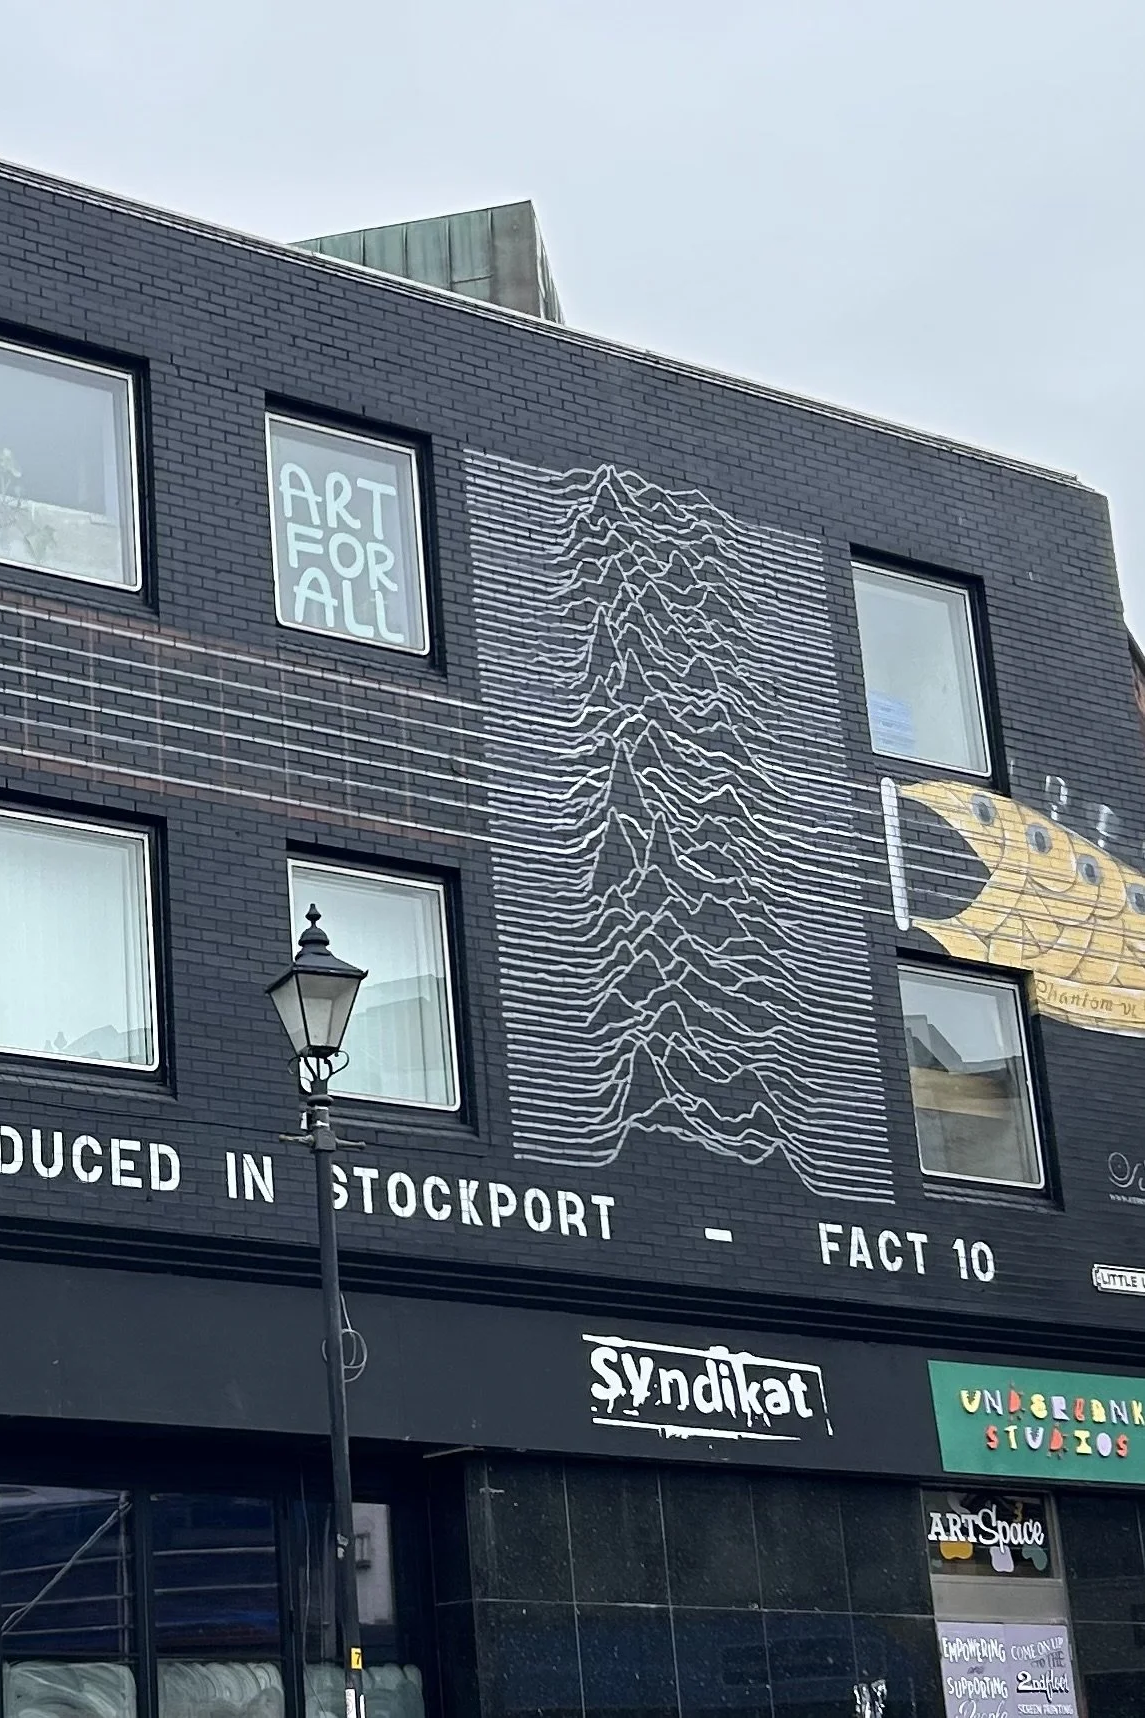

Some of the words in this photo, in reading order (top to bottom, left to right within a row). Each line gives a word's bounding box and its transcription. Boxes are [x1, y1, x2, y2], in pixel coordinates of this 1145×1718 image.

[279, 463, 396, 540] ART
[287, 522, 398, 592] FOR
[294, 567, 404, 643] ALL
[226, 1151, 275, 1203] IN
[332, 1164, 615, 1240] STOCKPORT
[818, 1222, 928, 1275] FACT
[952, 1238, 995, 1282] 10
[1100, 1272, 1138, 1288] LITTLE
[590, 1346, 814, 1420] Syndikat
[985, 1423, 1129, 1458] STUDIOS
[941, 1637, 1006, 1662] EMPOWERING
[1011, 1643, 1036, 1661] COME
[946, 1677, 1009, 1699] SUPPORTING
